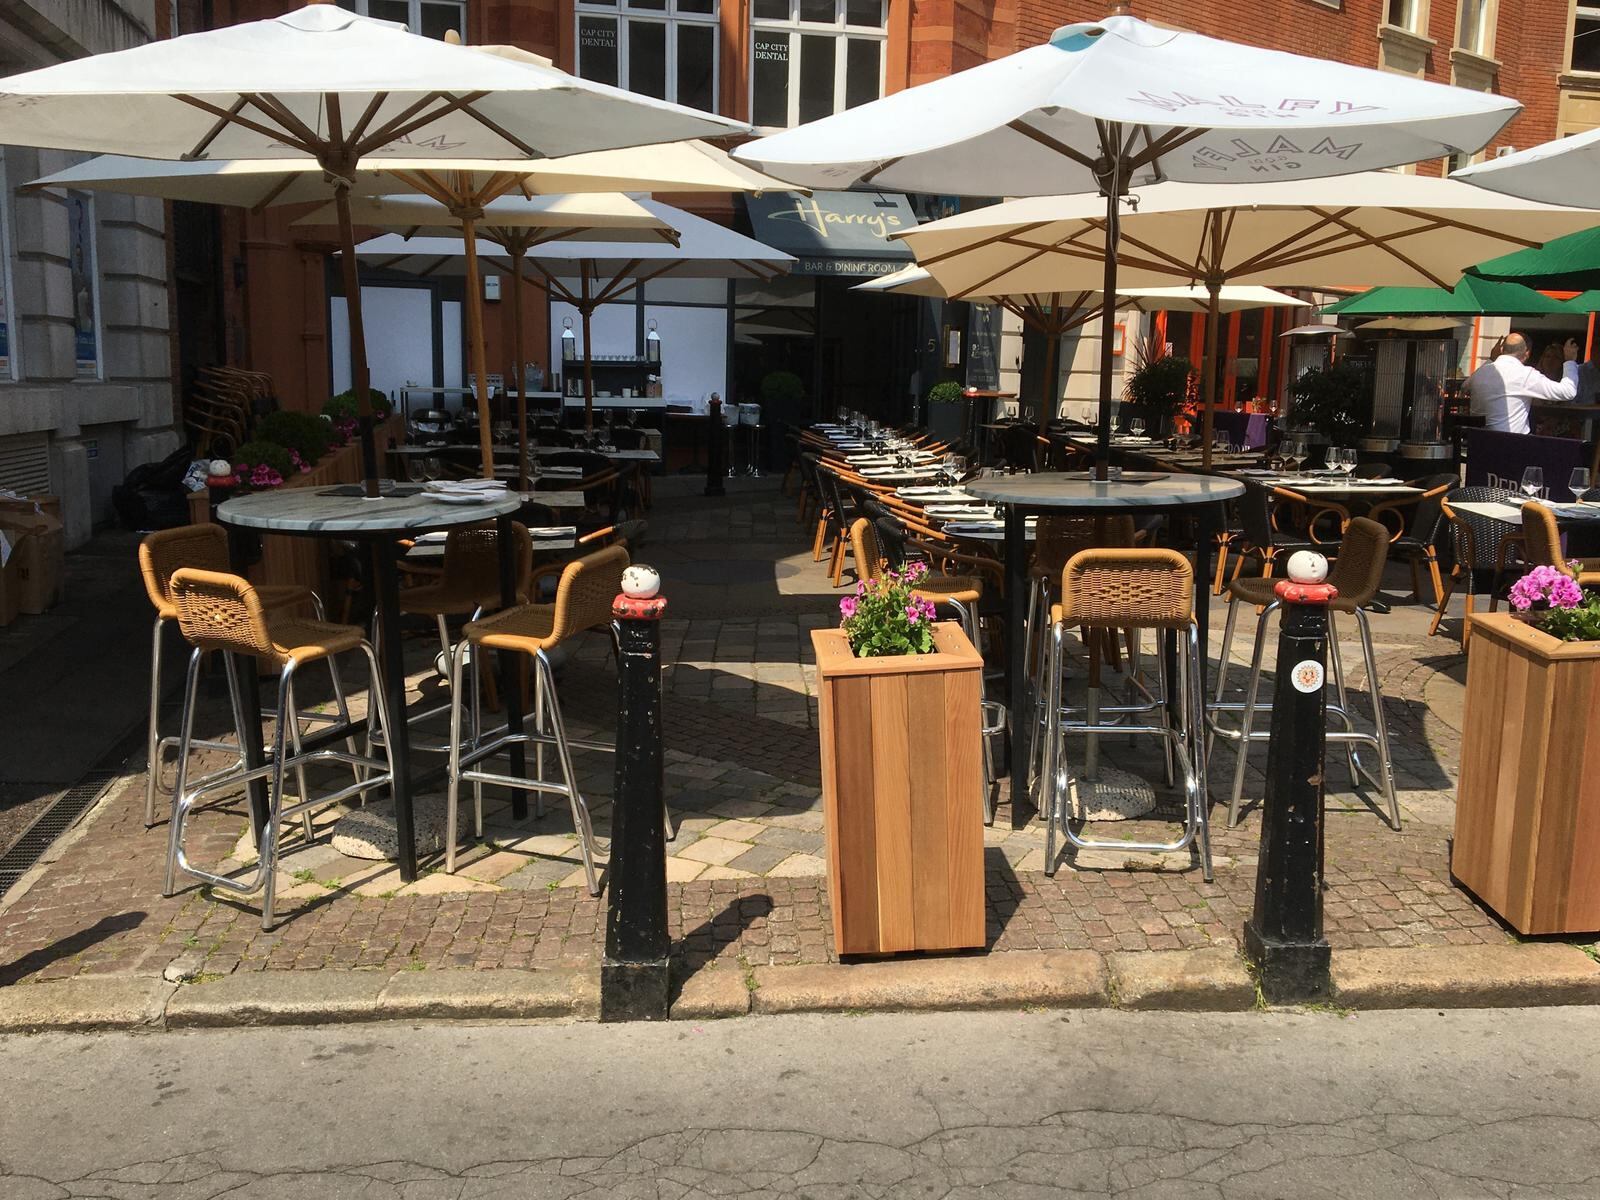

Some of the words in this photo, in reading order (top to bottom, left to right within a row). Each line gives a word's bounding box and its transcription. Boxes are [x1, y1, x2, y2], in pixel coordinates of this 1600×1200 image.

[581, 38, 616, 47] DENTAL
[755, 42, 769, 50] CAP
[755, 51, 788, 61] DENTAL
[1127, 91, 1386, 115] MALFY
[768, 200, 901, 238] Harry's
[805, 262, 822, 271] BAR
[825, 262, 832, 271] &
[835, 262, 866, 272] DINING
[868, 263, 896, 273] ROOM
